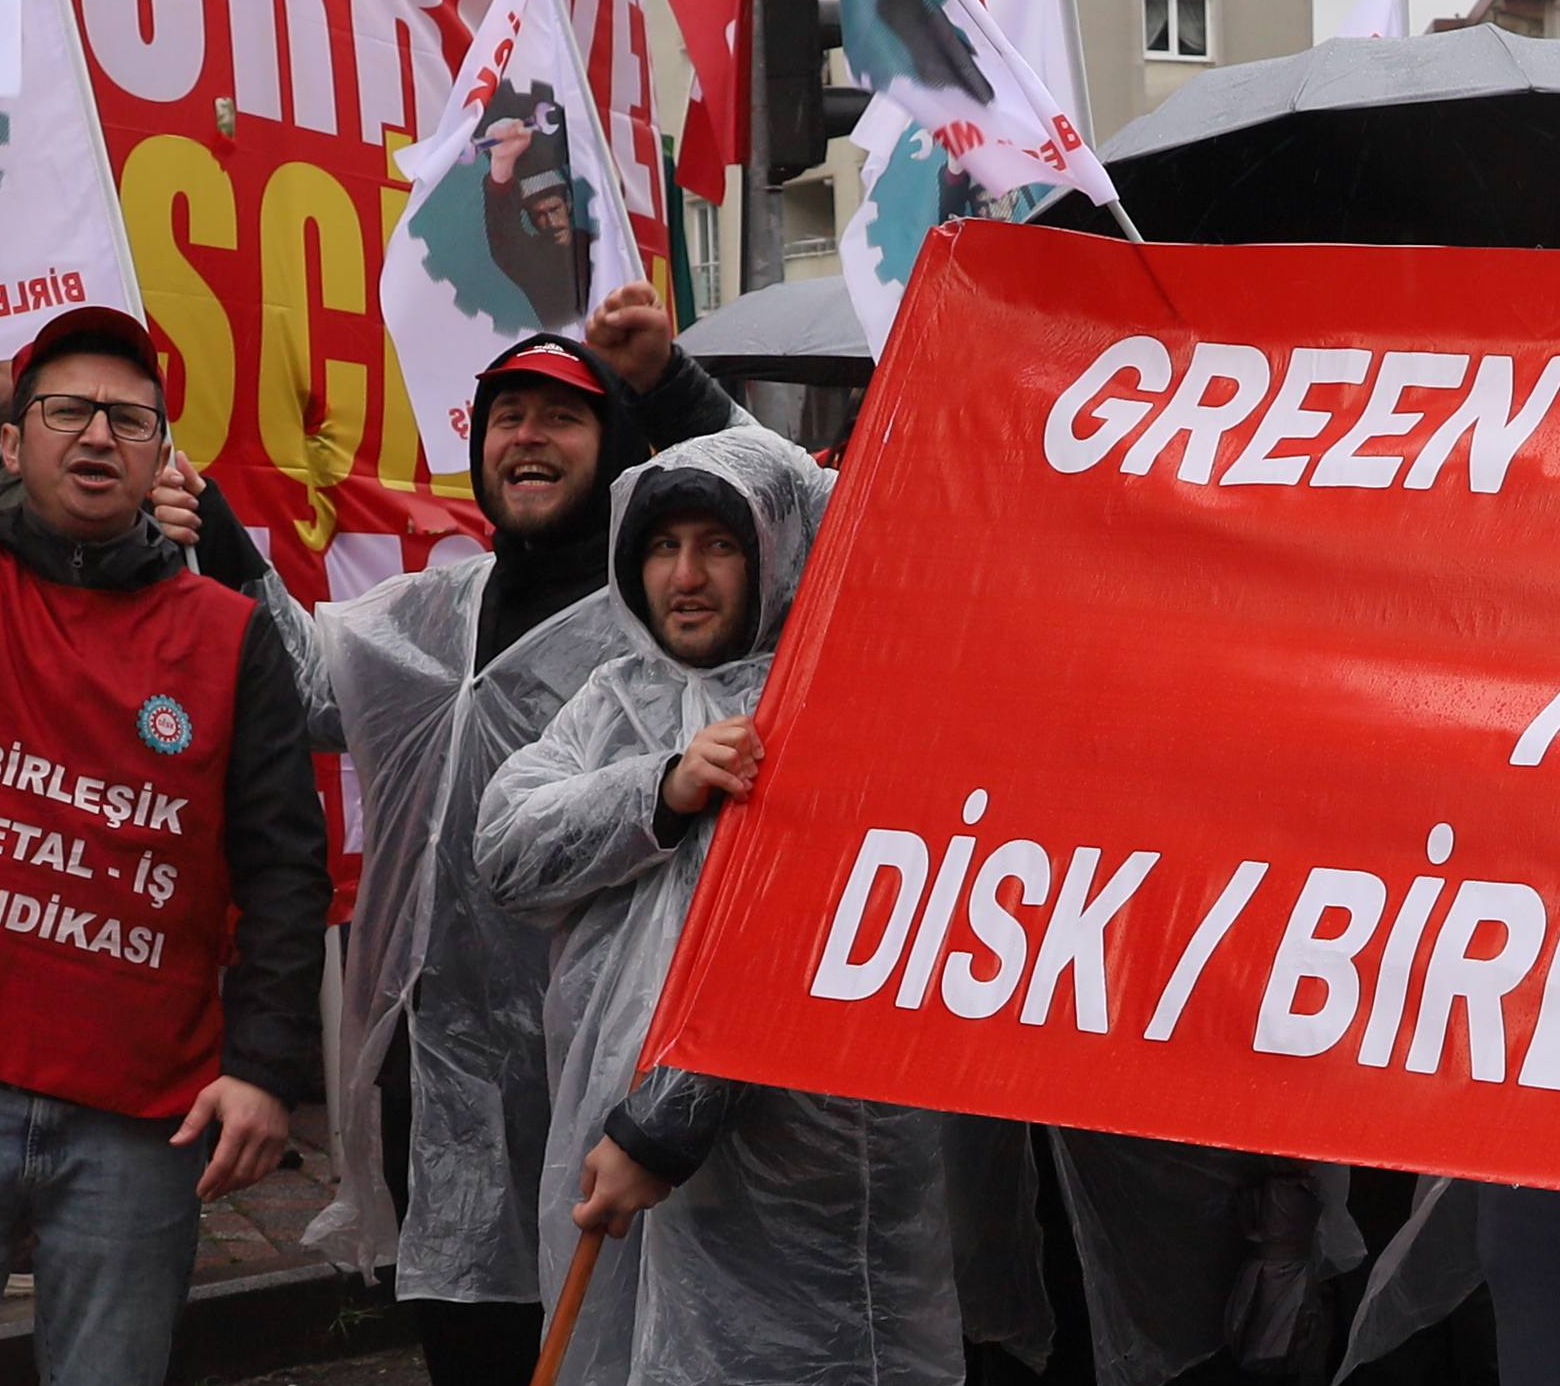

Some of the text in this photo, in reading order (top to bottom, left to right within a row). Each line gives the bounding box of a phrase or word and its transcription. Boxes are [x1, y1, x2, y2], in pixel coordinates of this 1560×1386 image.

[132, 848, 180, 910] İŞ
[810, 788, 1161, 1034] DİSK
[1143, 860, 1269, 1041] /
